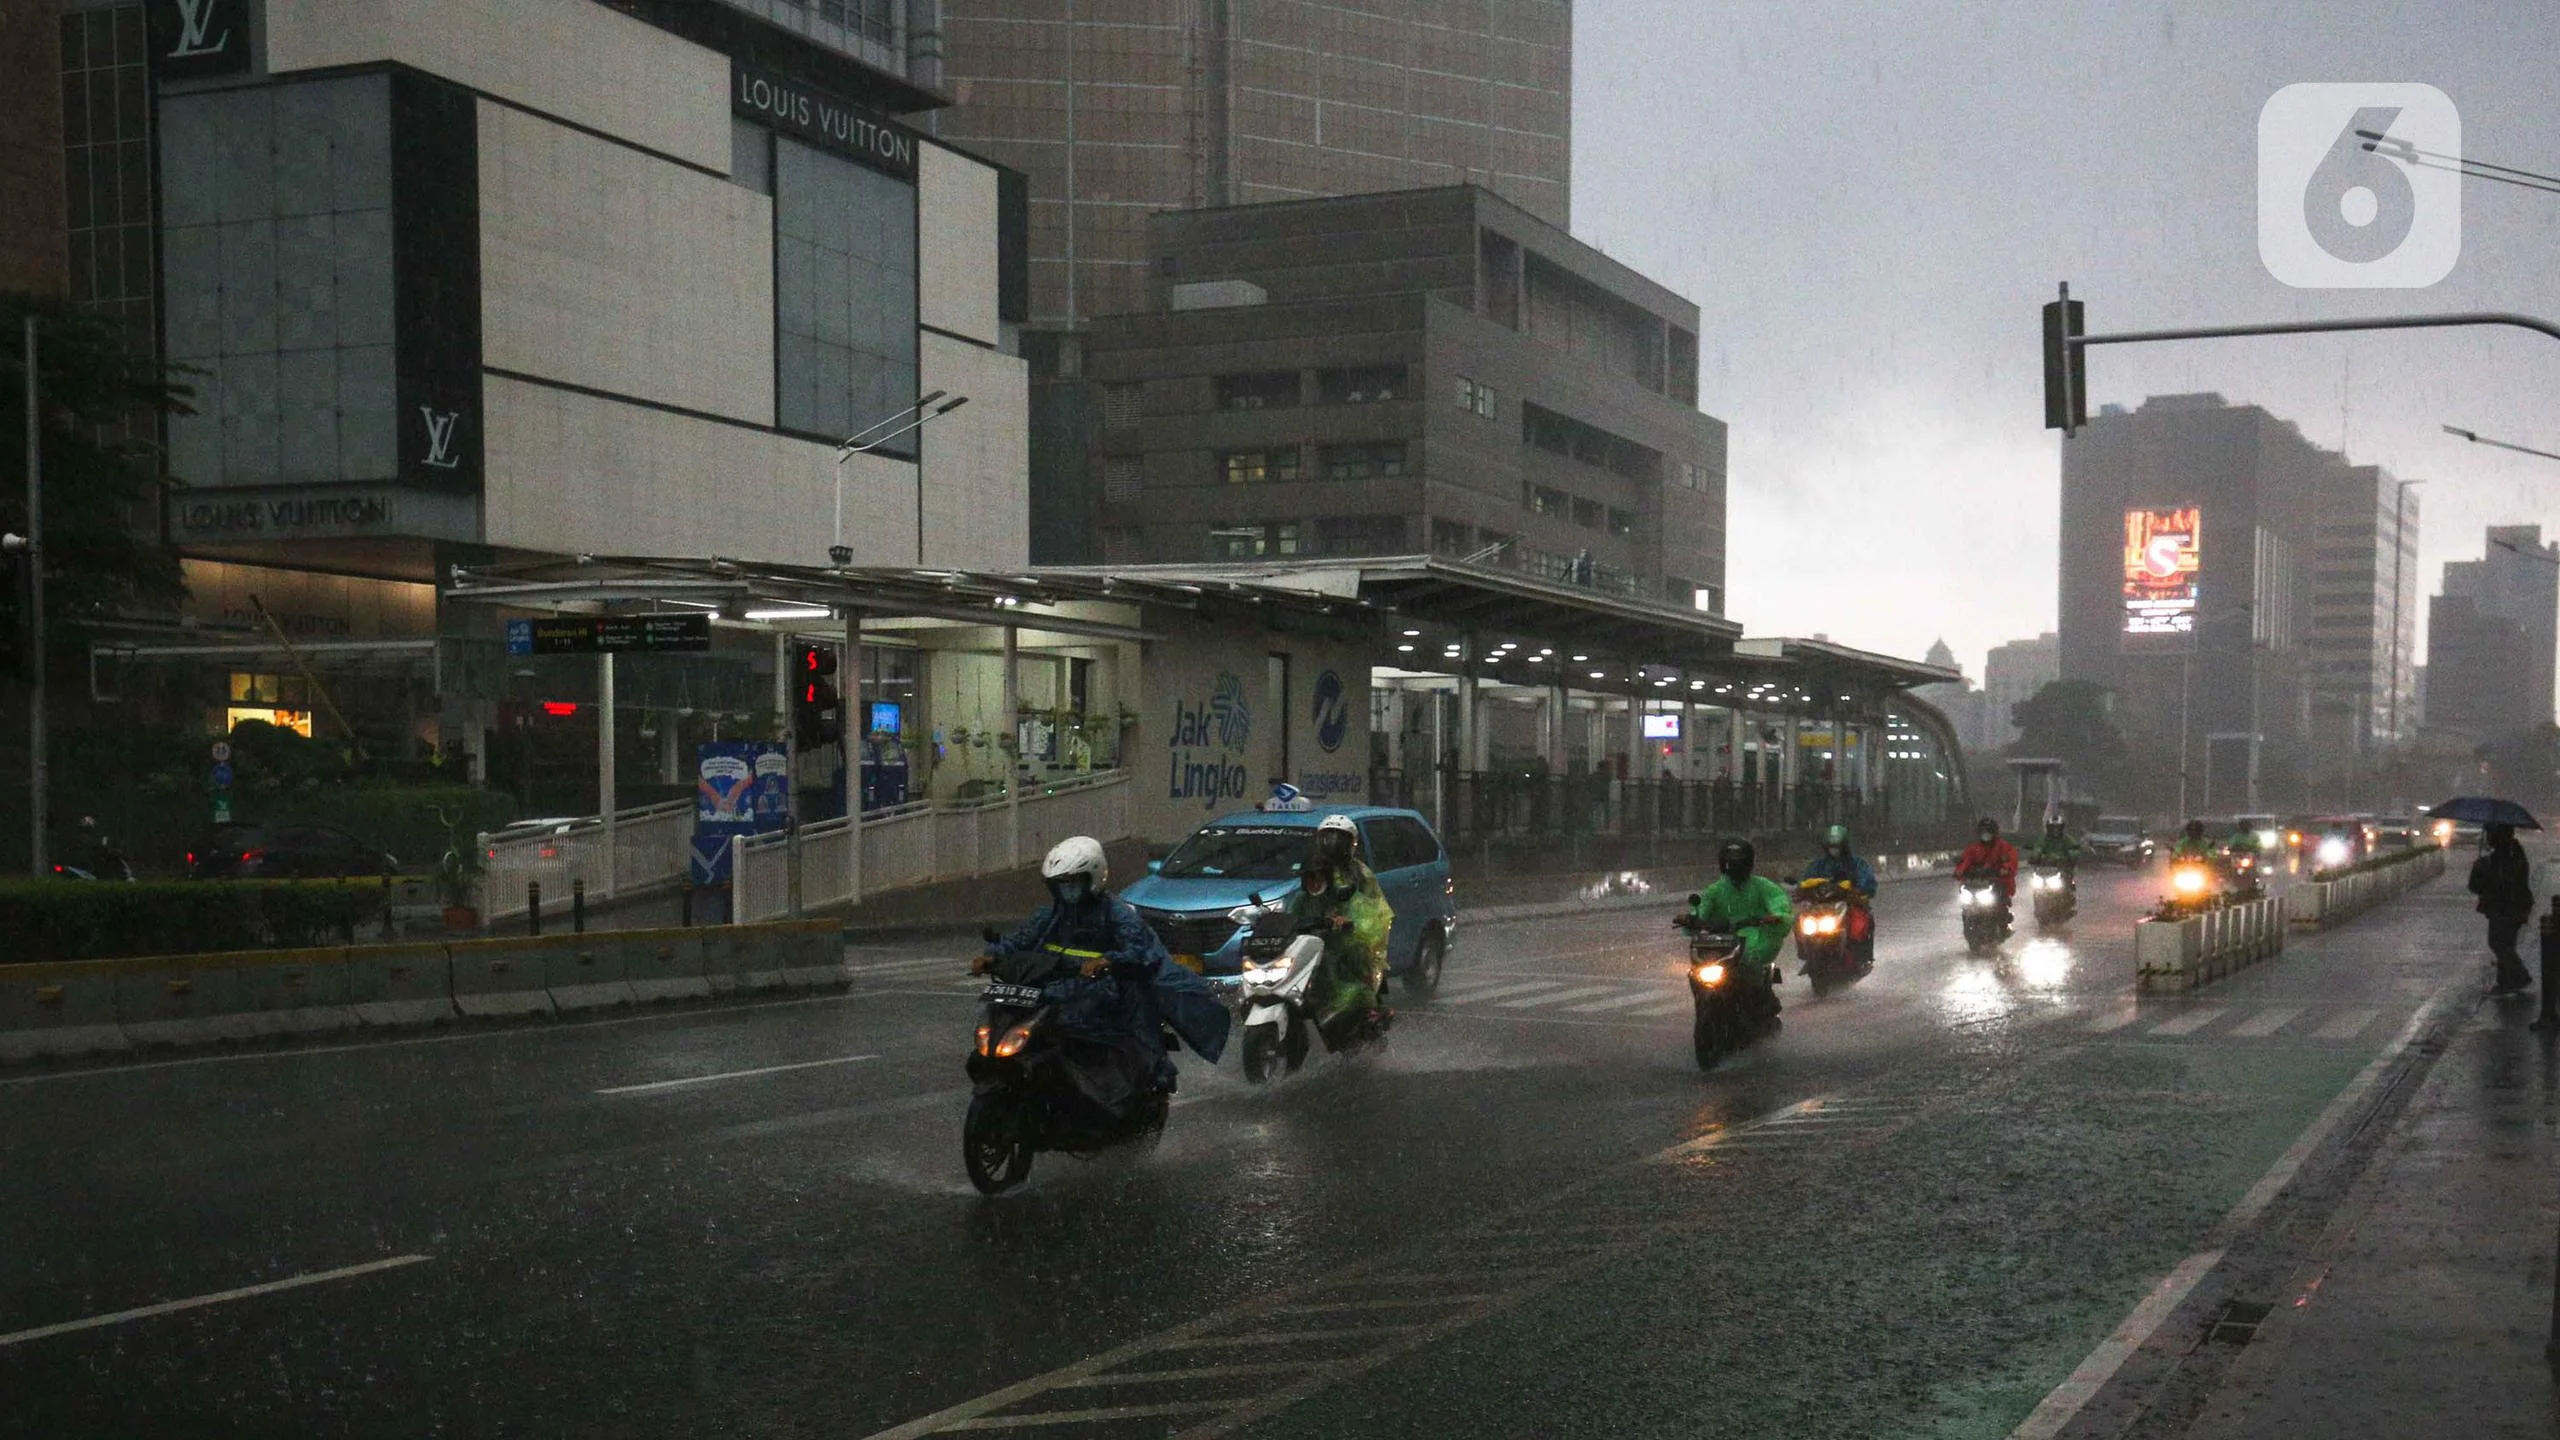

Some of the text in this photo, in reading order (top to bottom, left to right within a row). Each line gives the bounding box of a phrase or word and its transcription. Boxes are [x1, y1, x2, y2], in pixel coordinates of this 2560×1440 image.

[742, 72, 910, 166] LOUIS VUITTON
[420, 406, 461, 468] LV
[266, 497, 392, 526] VUITTON
[1170, 699, 1211, 747] Jak
[1171, 752, 1246, 810] Lingko
[1271, 802, 1301, 810] TAKSI
[1235, 828, 1284, 836] Bluebird
